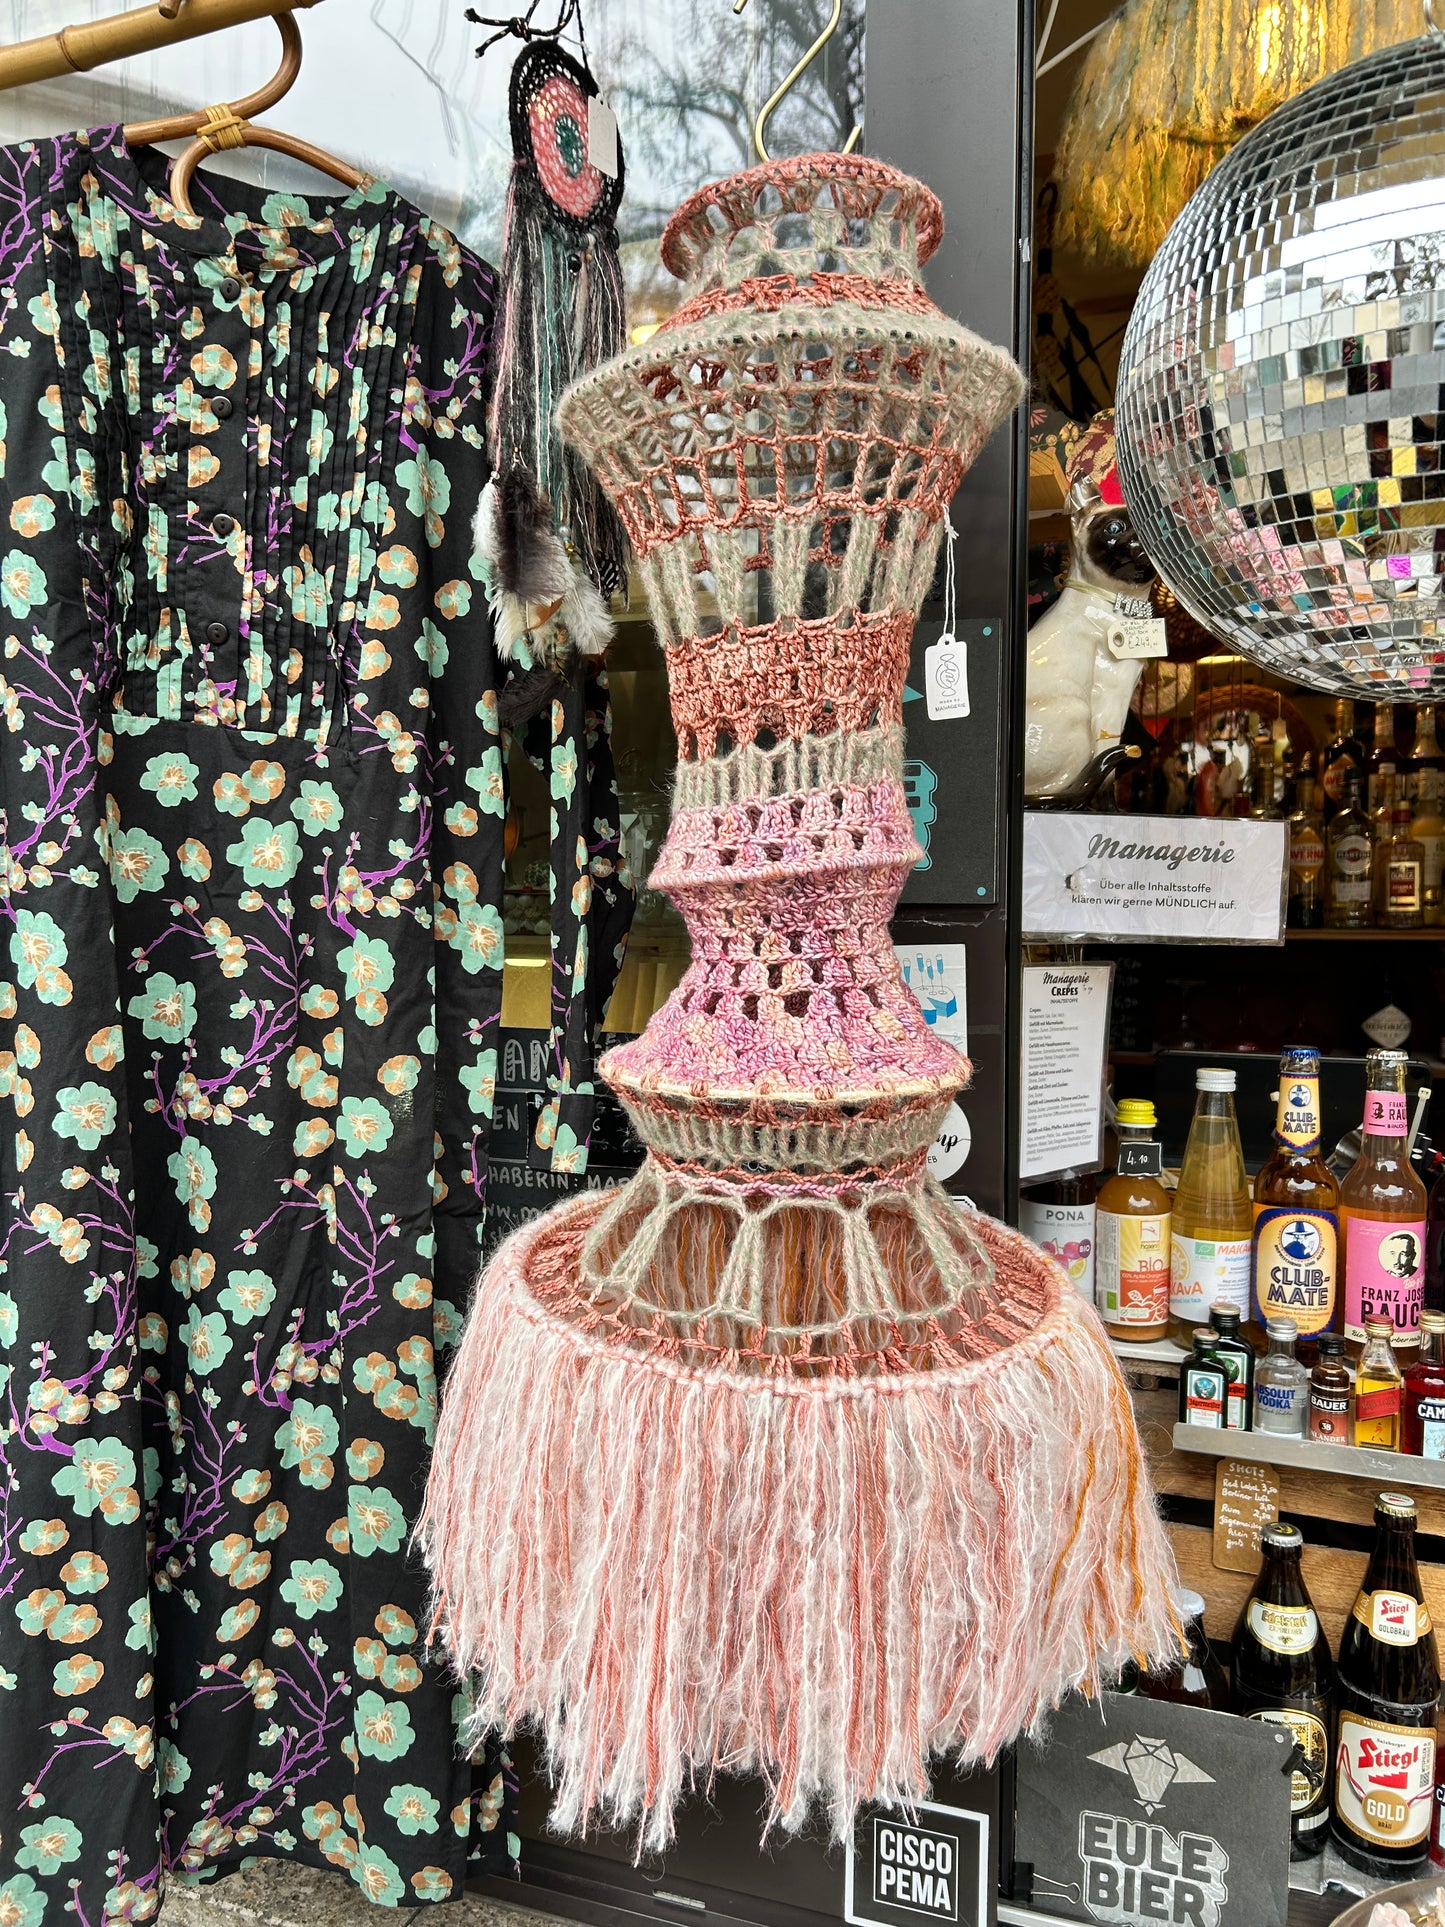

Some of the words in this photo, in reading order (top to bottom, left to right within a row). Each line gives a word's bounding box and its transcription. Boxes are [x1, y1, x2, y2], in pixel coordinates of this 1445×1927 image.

[1087, 834, 1235, 871] Managerie
[1100, 877, 1125, 890] Über
[1127, 881, 1145, 891] alle
[1148, 881, 1212, 893] Inhaltsstoffe
[1072, 894, 1101, 904] klären
[1104, 896, 1120, 905] wir
[1123, 898, 1152, 908] gerne
[1155, 895, 1216, 909] MÜNDLICH
[1218, 900, 1237, 910] auf.
[1043, 971, 1090, 988] Managerie
[1051, 986, 1079, 996] CREPES
[1284, 1112, 1317, 1123] CLUB-
[1282, 1122, 1316, 1133] MATE
[1046, 1210, 1085, 1221] PONA
[1080, 1244, 1090, 1252] BIO
[1270, 1266, 1331, 1287] CLUB-
[1266, 1283, 1329, 1306] MATE
[1361, 1286, 1400, 1302] FRANZ
[1255, 1382, 1296, 1400] ABSOLUT
[1257, 1393, 1291, 1409] VODKA
[1311, 1395, 1347, 1411] BAUER
[1321, 1422, 1332, 1431] 38
[1229, 1462, 1265, 1478] SHOTS
[1221, 1503, 1241, 1515] Rum
[1380, 1599, 1409, 1616] Stiegl
[1378, 1624, 1411, 1638] GOLDBRÄU
[1358, 1738, 1419, 1770] Stiegl
[1367, 1798, 1405, 1822] GOLD
[880, 1828, 952, 1875] CISCO
[1084, 1815, 1213, 1884] EULE
[880, 1863, 952, 1911] PEMA
[1088, 1860, 1206, 1927] BIER
